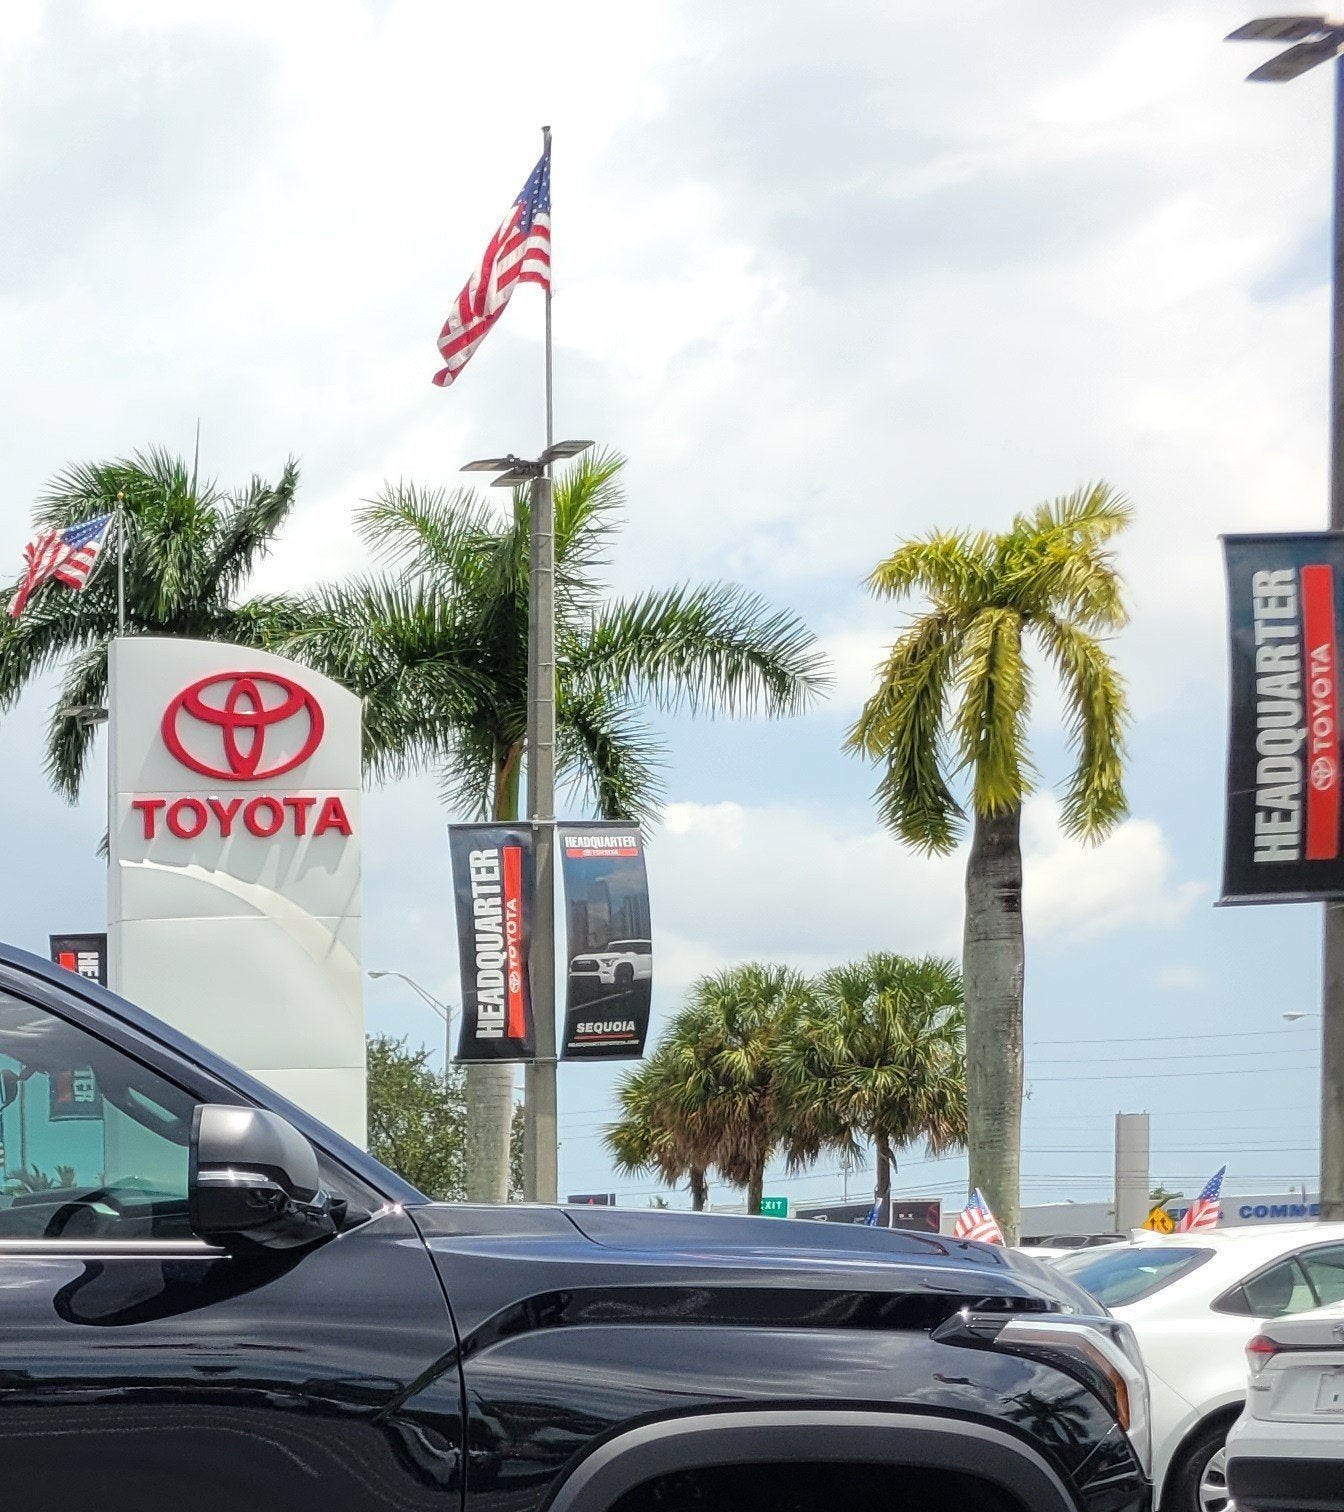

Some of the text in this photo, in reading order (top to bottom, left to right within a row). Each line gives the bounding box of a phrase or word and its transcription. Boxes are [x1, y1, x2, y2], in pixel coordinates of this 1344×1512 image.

[1252, 567, 1309, 863] HEADQUARTER
[1311, 643, 1333, 755] TOYOTA
[132, 795, 353, 840] TOYOTA
[564, 836, 637, 848] HEADQUARTER
[468, 848, 507, 1039] HEADQUARTER
[505, 898, 522, 971] TOYOTA
[576, 1020, 636, 1034] SEQUOIA
